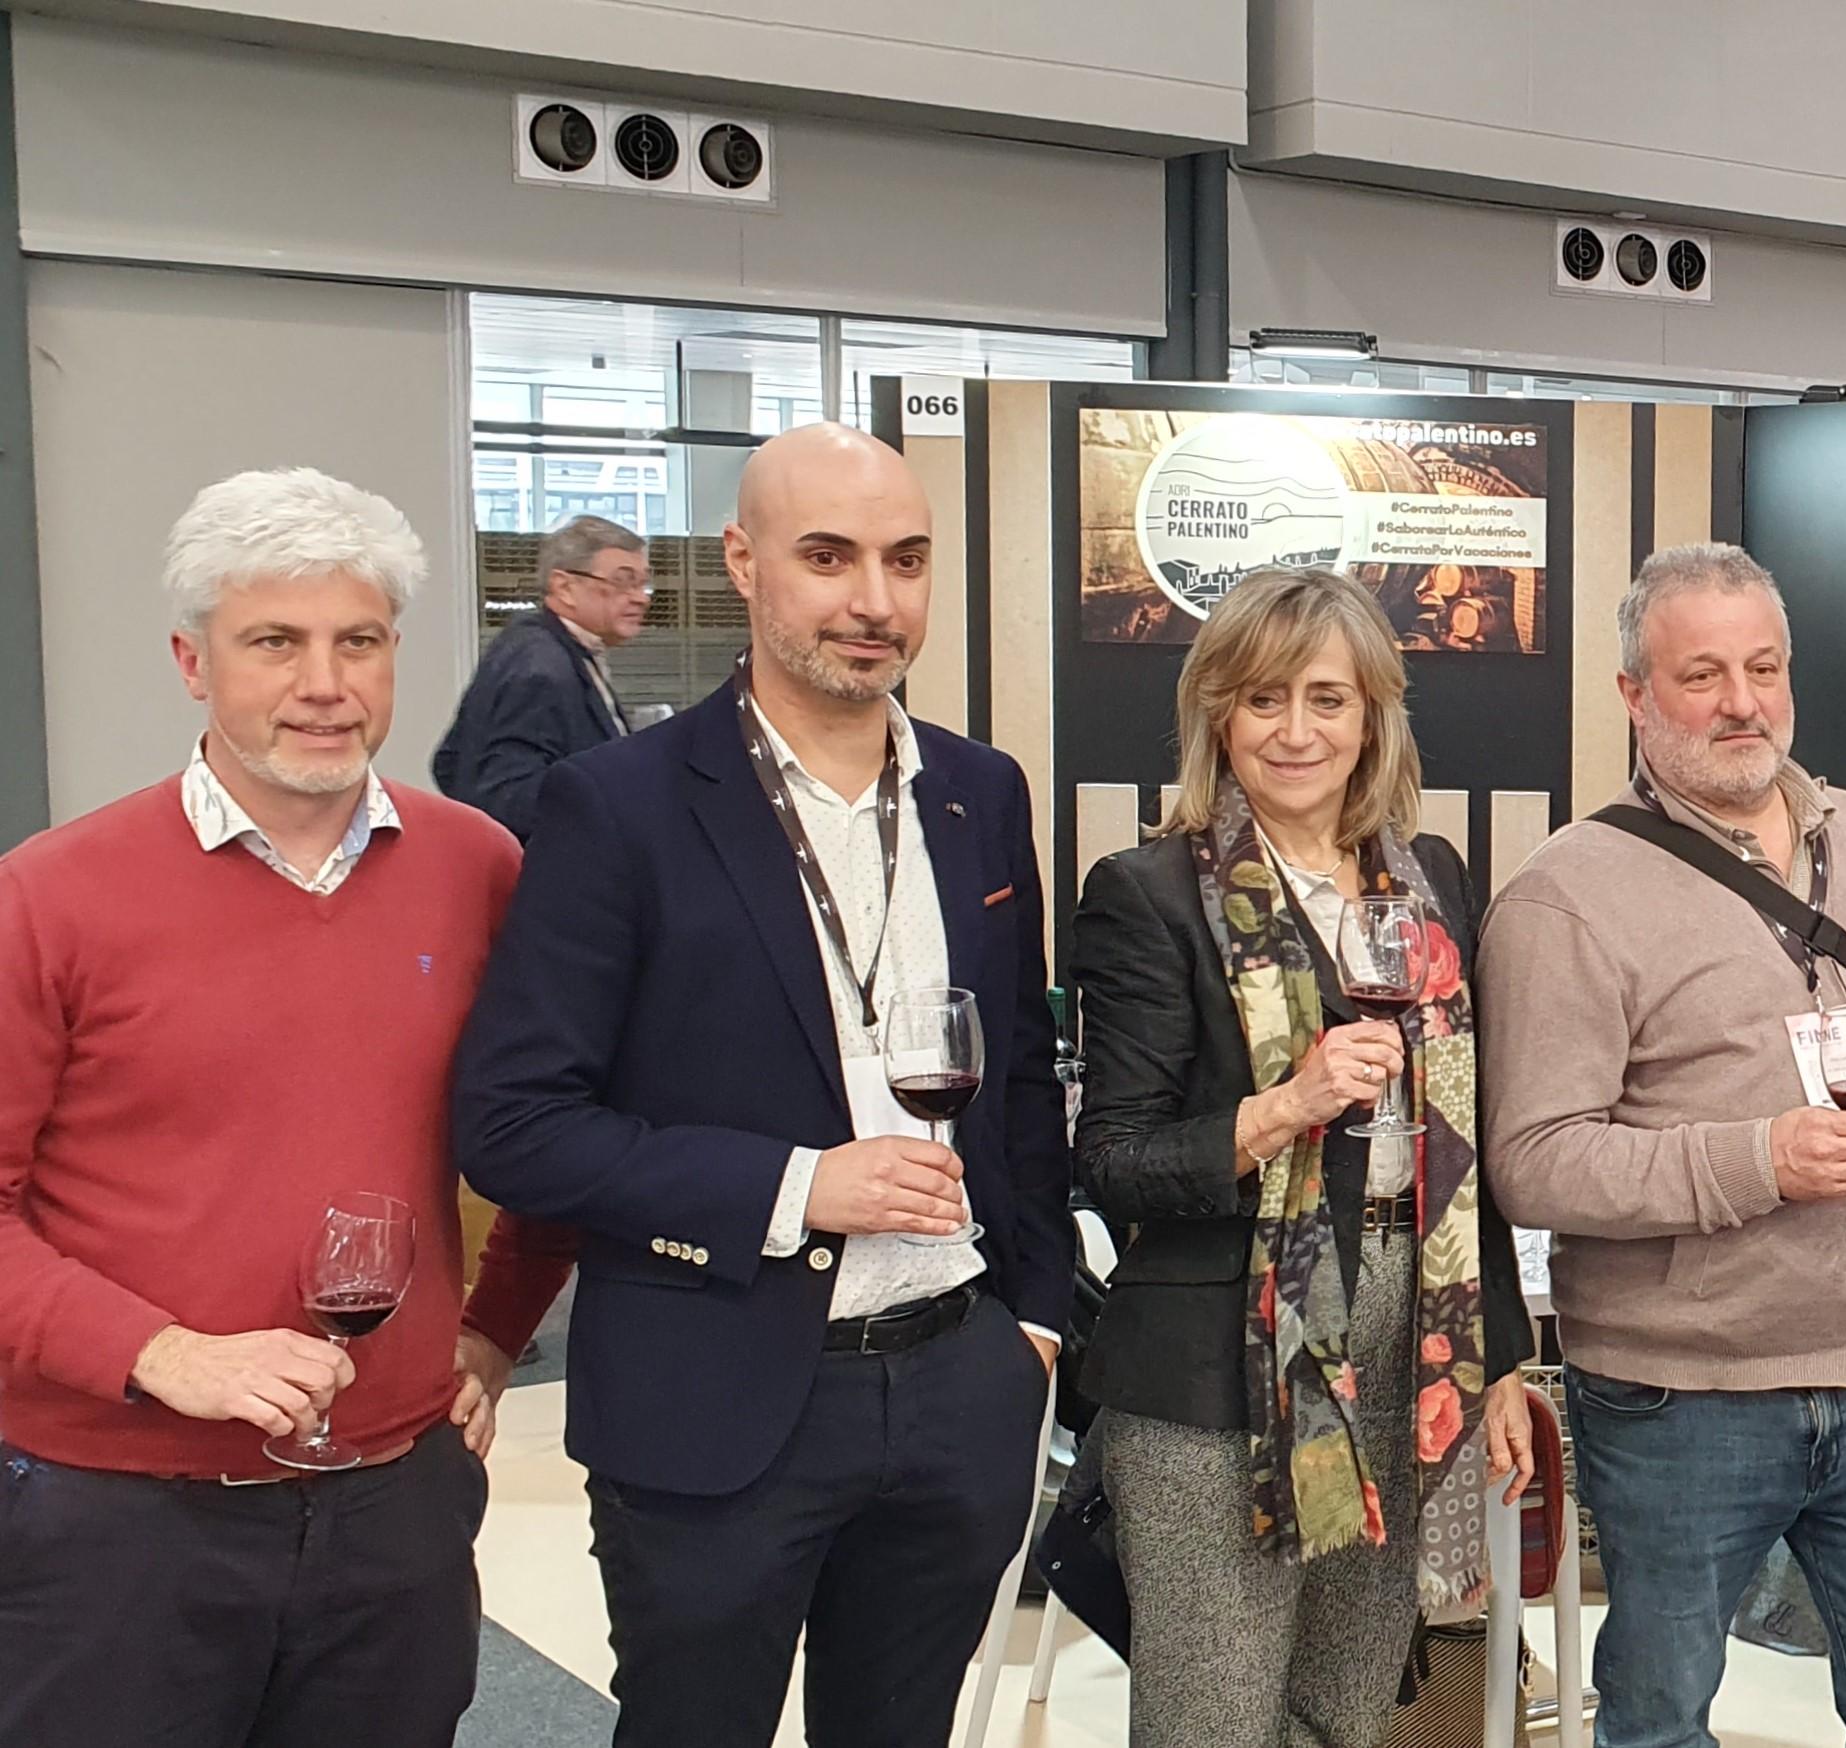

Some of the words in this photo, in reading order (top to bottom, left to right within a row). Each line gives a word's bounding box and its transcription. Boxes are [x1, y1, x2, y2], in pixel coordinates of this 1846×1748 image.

[907, 395, 959, 416] 066
[1168, 484, 1191, 497] ADRI
[1168, 499, 1248, 520] CERRATO
[1391, 501, 1514, 518] #CerratoPalentino
[1168, 521, 1249, 540] PALENTINO
[1371, 541, 1532, 559] #CerratoPorVacaciones
